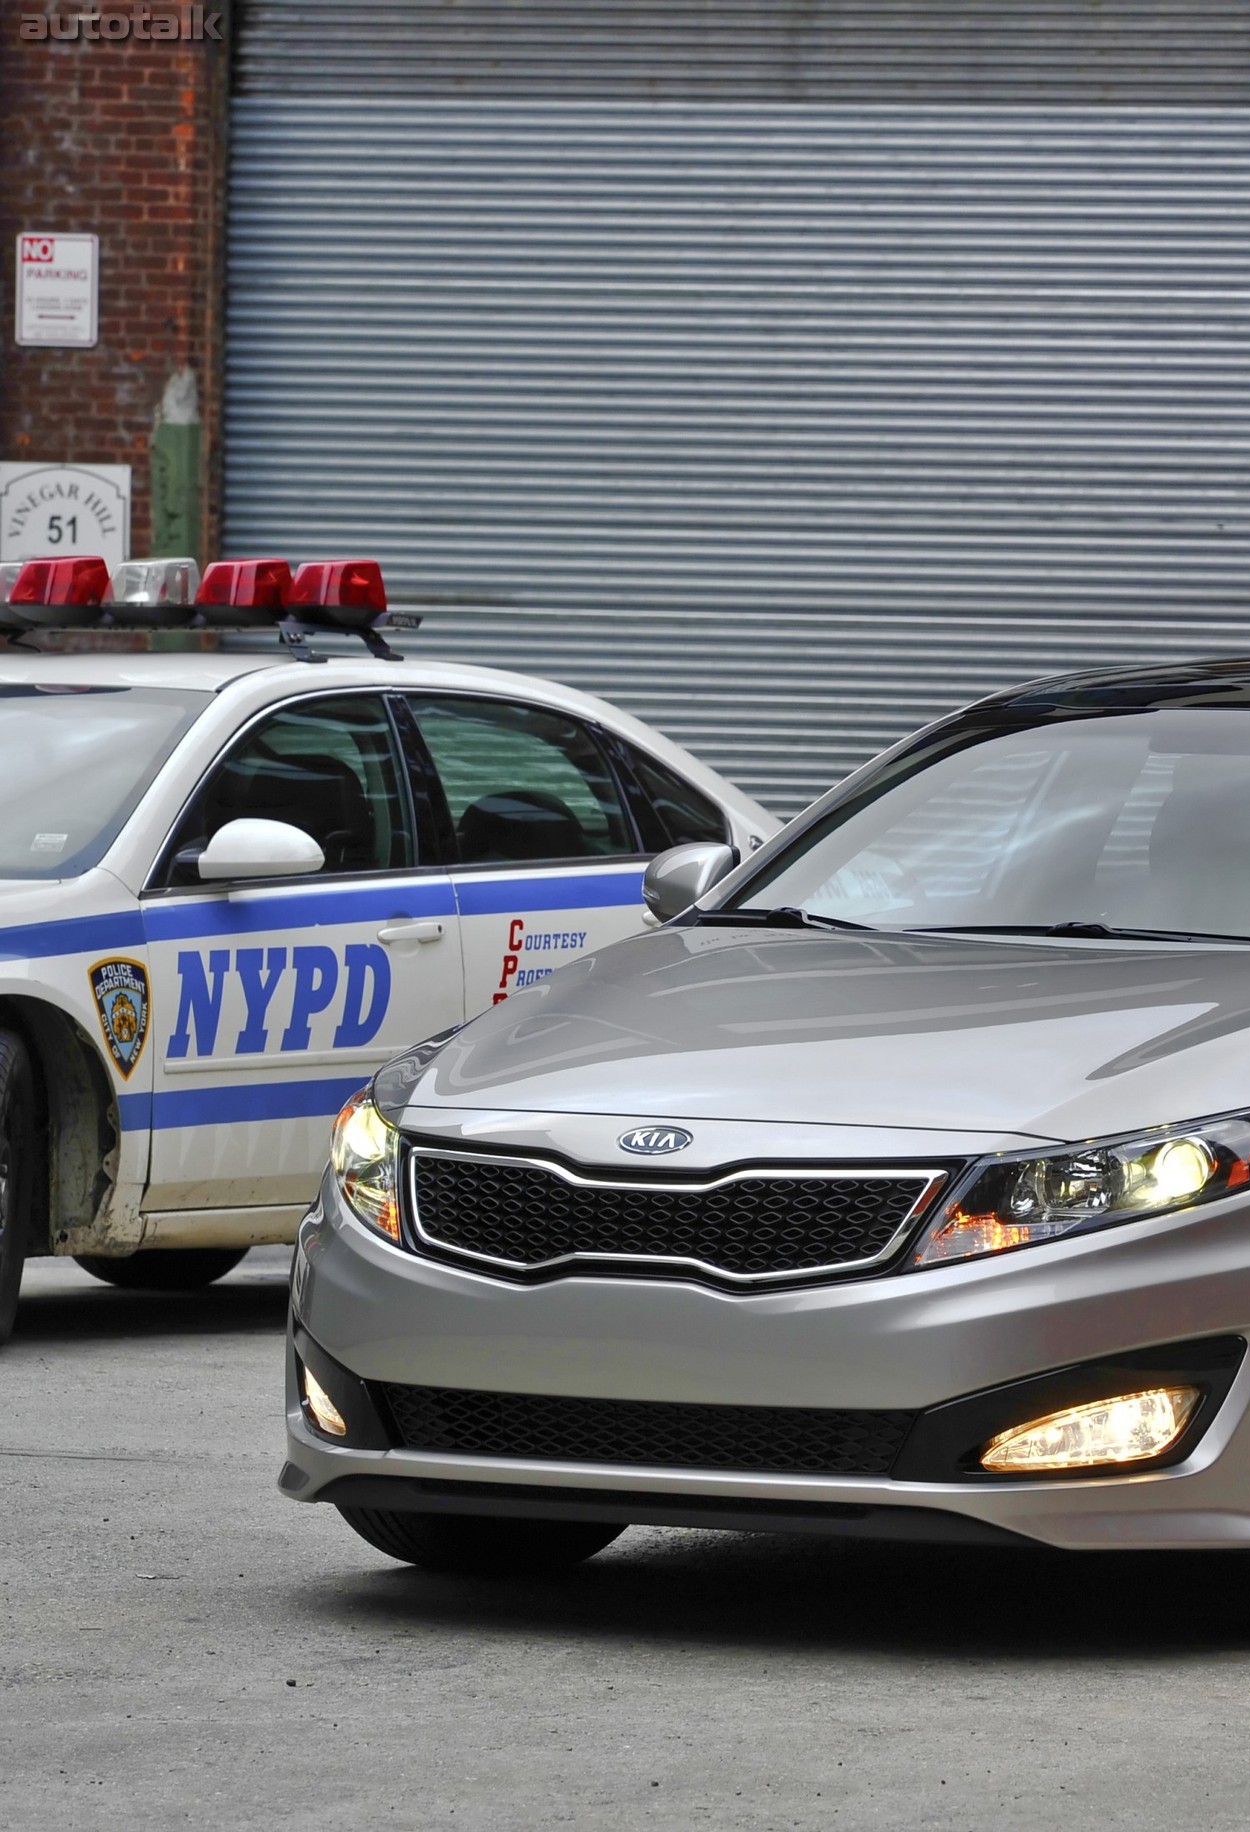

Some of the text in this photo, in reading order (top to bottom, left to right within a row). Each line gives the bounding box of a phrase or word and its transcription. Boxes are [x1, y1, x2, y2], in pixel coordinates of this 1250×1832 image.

[23, 239, 54, 261] NO
[26, 268, 88, 281] PARKING
[8, 482, 116, 538] VINEGAR HILL
[48, 515, 77, 545] 51
[509, 919, 587, 951] COURTESY
[100, 963, 133, 980] POLICE
[95, 976, 146, 1000] DEPARTMENT
[166, 944, 391, 1058] NYPD
[101, 1013, 121, 1059] CITY OF
[129, 1002, 147, 1063] NEW YORK
[631, 1131, 676, 1149] KIA
